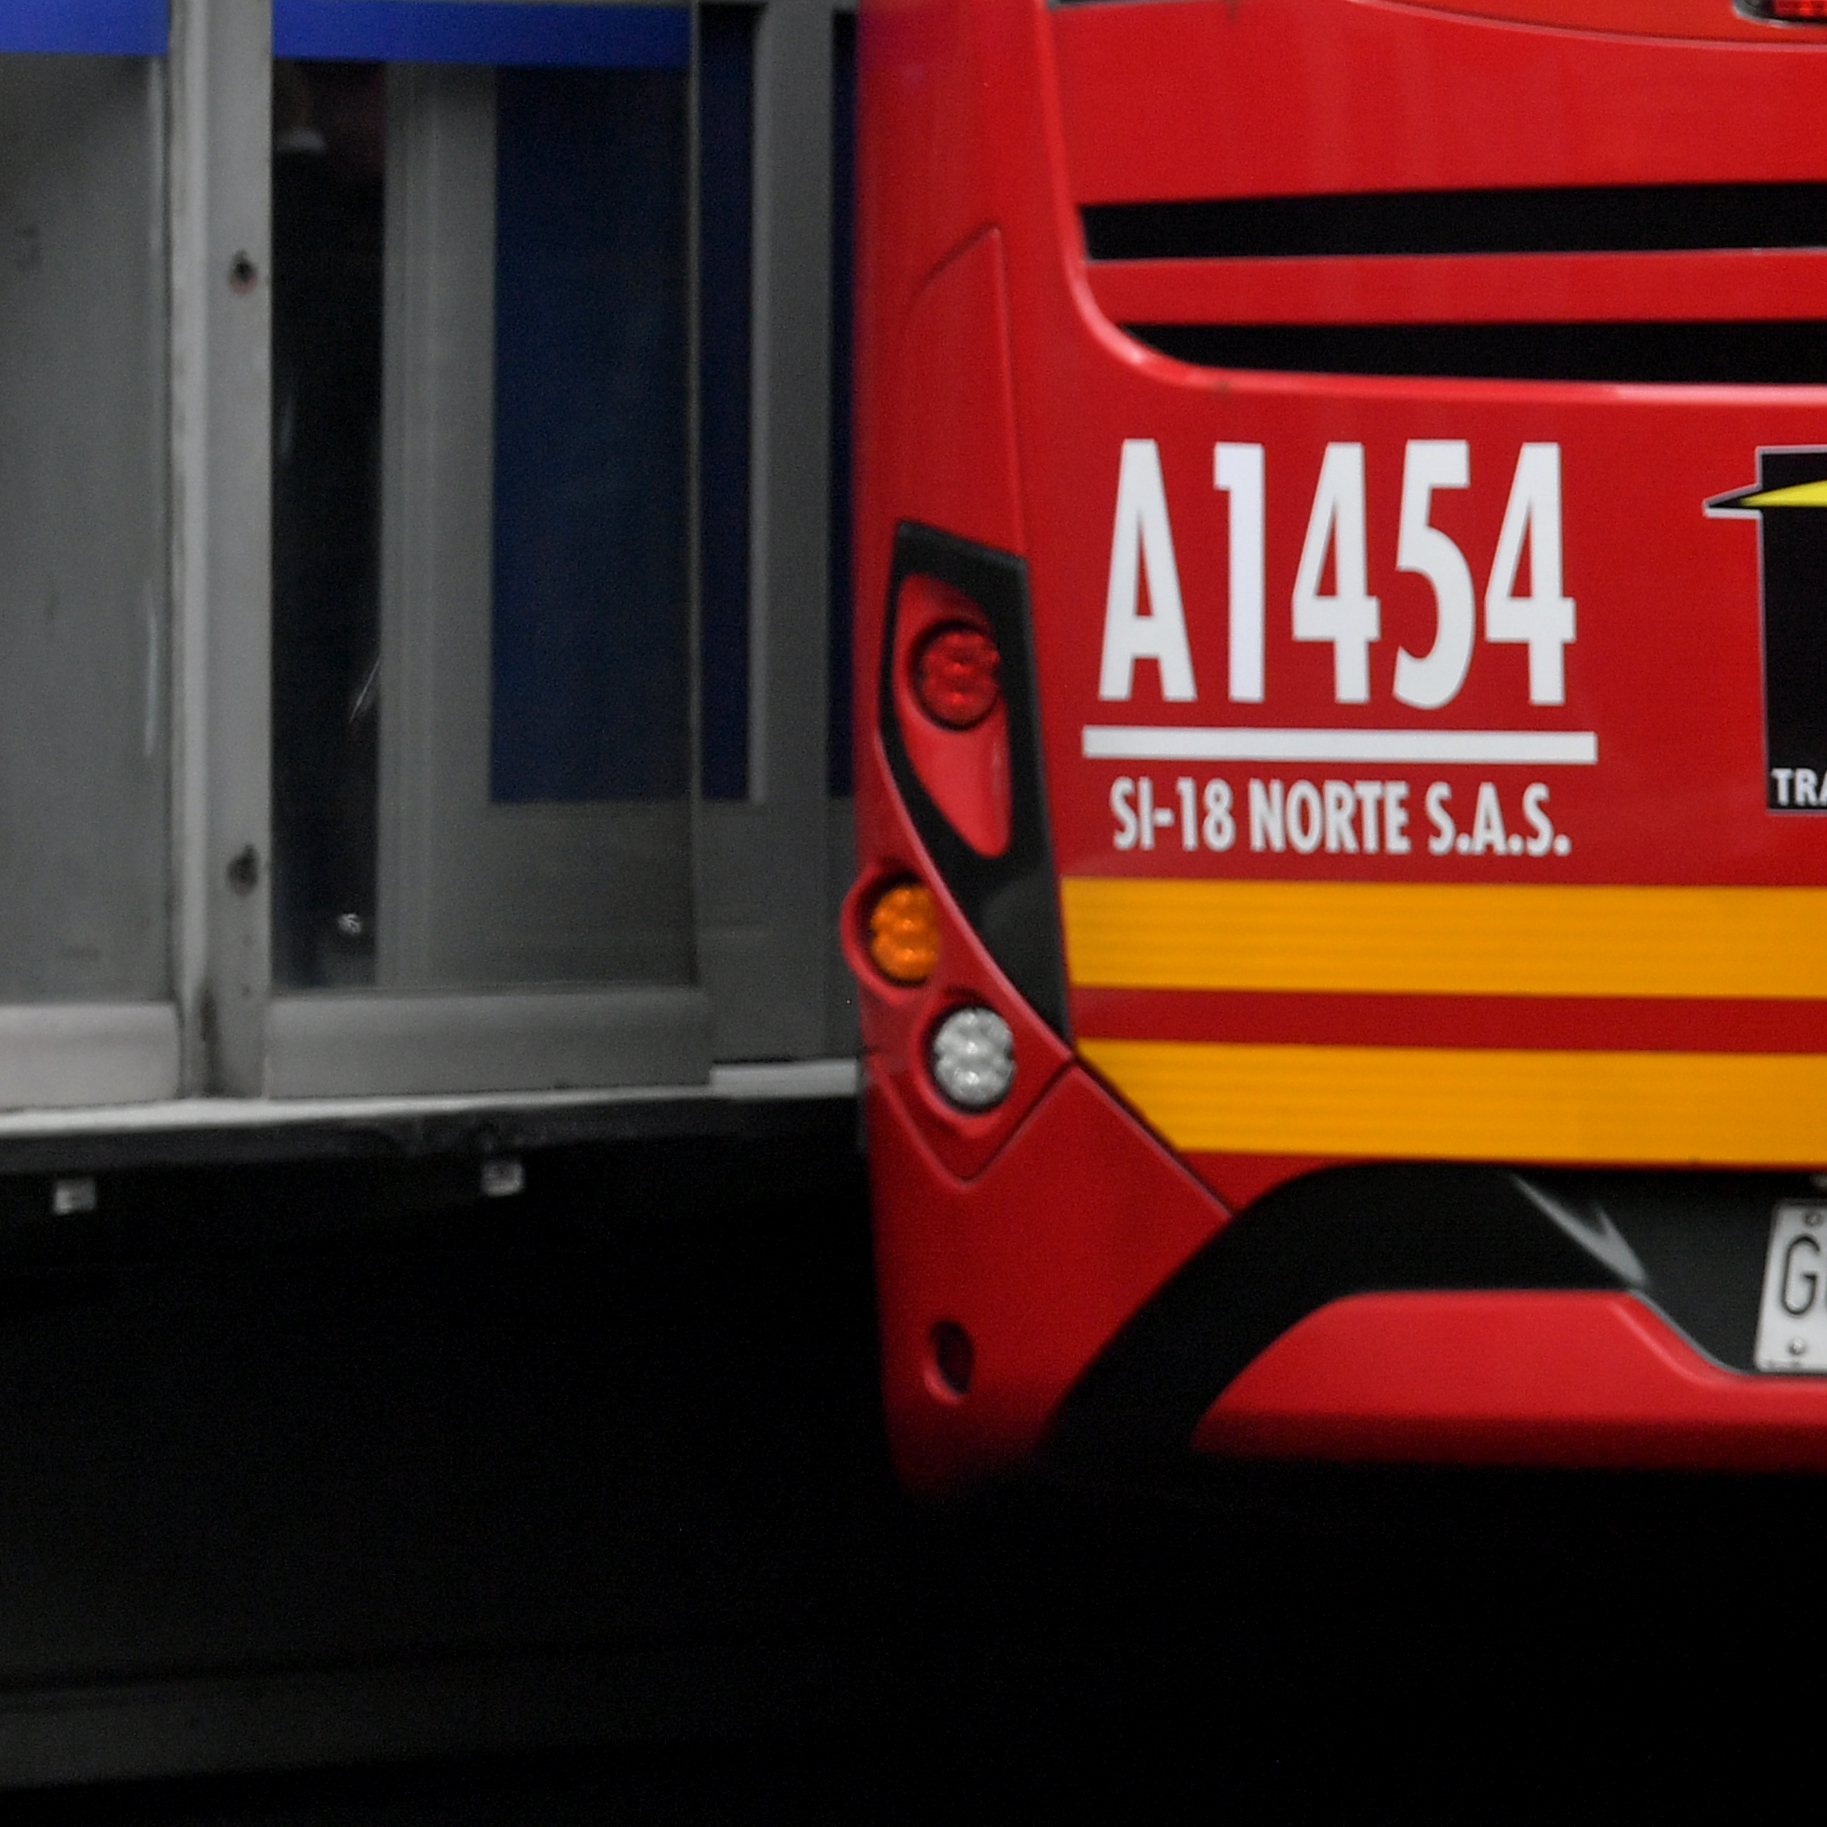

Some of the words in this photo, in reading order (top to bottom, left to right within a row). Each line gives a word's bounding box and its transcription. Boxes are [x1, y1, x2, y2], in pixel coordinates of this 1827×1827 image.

[1098, 438, 1577, 710] A1454
[1108, 775, 1237, 853] SI-18
[1247, 777, 1412, 855] NORTE
[1424, 780, 1573, 858] S.A.S.
